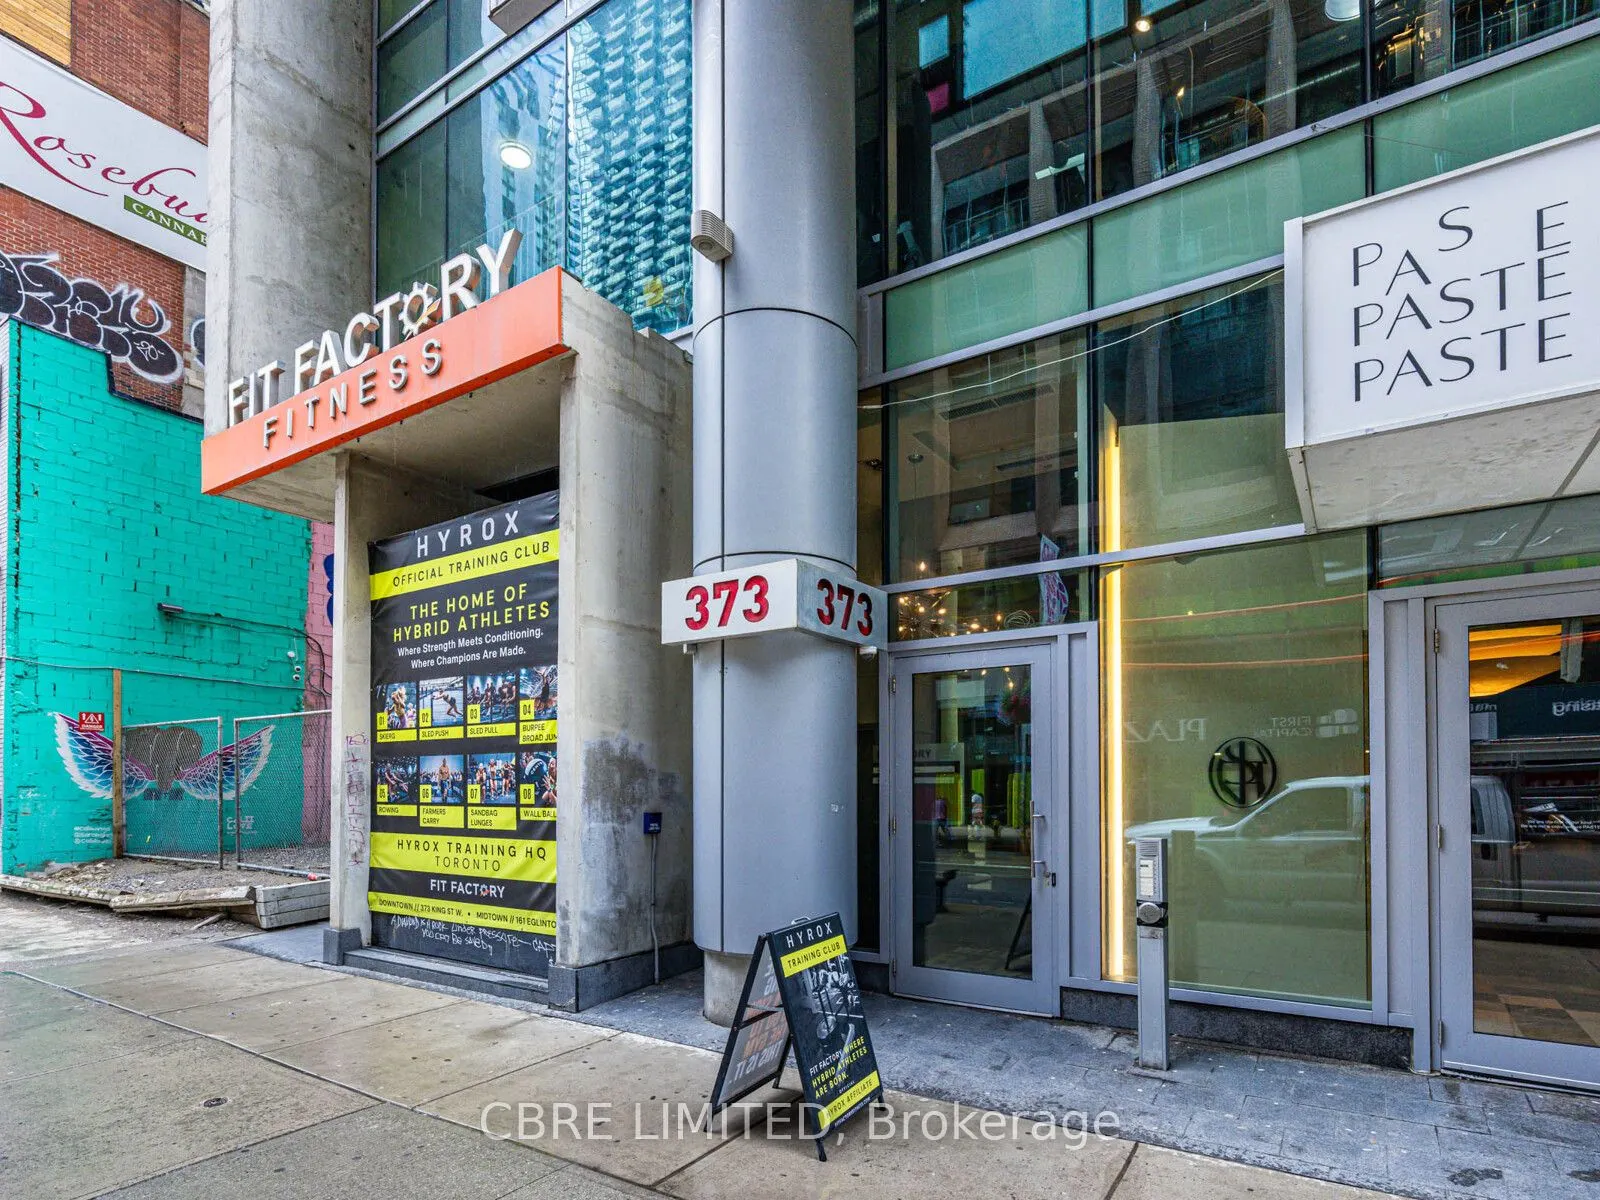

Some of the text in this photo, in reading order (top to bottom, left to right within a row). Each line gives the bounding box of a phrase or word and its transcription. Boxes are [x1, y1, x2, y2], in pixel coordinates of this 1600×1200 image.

[1353, 251, 1572, 347] PASTE
[228, 360, 285, 427] FIT
[293, 228, 523, 395] FACTORY
[1354, 312, 1572, 402] PASTE
[263, 337, 443, 448] FITNESS
[417, 510, 519, 558] HYROX
[392, 541, 550, 587] OFFICIAL TRAINING CLUB
[410, 583, 528, 621] THE HOME OF
[684, 574, 770, 631] 373
[816, 578, 873, 637] 373
[393, 601, 550, 643] HYBRID ATHLETES
[397, 627, 544, 657] Where Strength Meets Conditioning.
[411, 645, 527, 669] Where Champions Are Made.
[379, 716, 385, 725] 01
[422, 713, 428, 723] 02
[470, 709, 477, 719] 03
[522, 704, 531, 715] 04
[422, 730, 434, 738] SLED
[470, 726, 498, 735] SLED PULL
[522, 723, 545, 732] BURPEE
[379, 789, 385, 798] 05
[422, 788, 429, 798] 06
[470, 789, 478, 799] 07
[523, 789, 532, 799] 08
[397, 839, 546, 860] HYROX TRAINING HQ
[435, 856, 501, 871] TORONTO
[430, 879, 505, 898] FIT FACTORY
[379, 898, 413, 910] DOWNTOWN
[420, 904, 430, 912] 373
[431, 906, 446, 914] KING
[476, 912, 508, 922] MIDTOWN
[516, 916, 525, 925] 161
[785, 921, 833, 948] HYROX
[787, 942, 841, 969] TRAINING CLUB
[809, 1036, 865, 1076] FIT FACTORY WHERE
[812, 1046, 868, 1088] HYBRID ATHLETES
[815, 1072, 849, 1100] ARE BORN.
[846, 1079, 873, 1103] AFFILIATE
